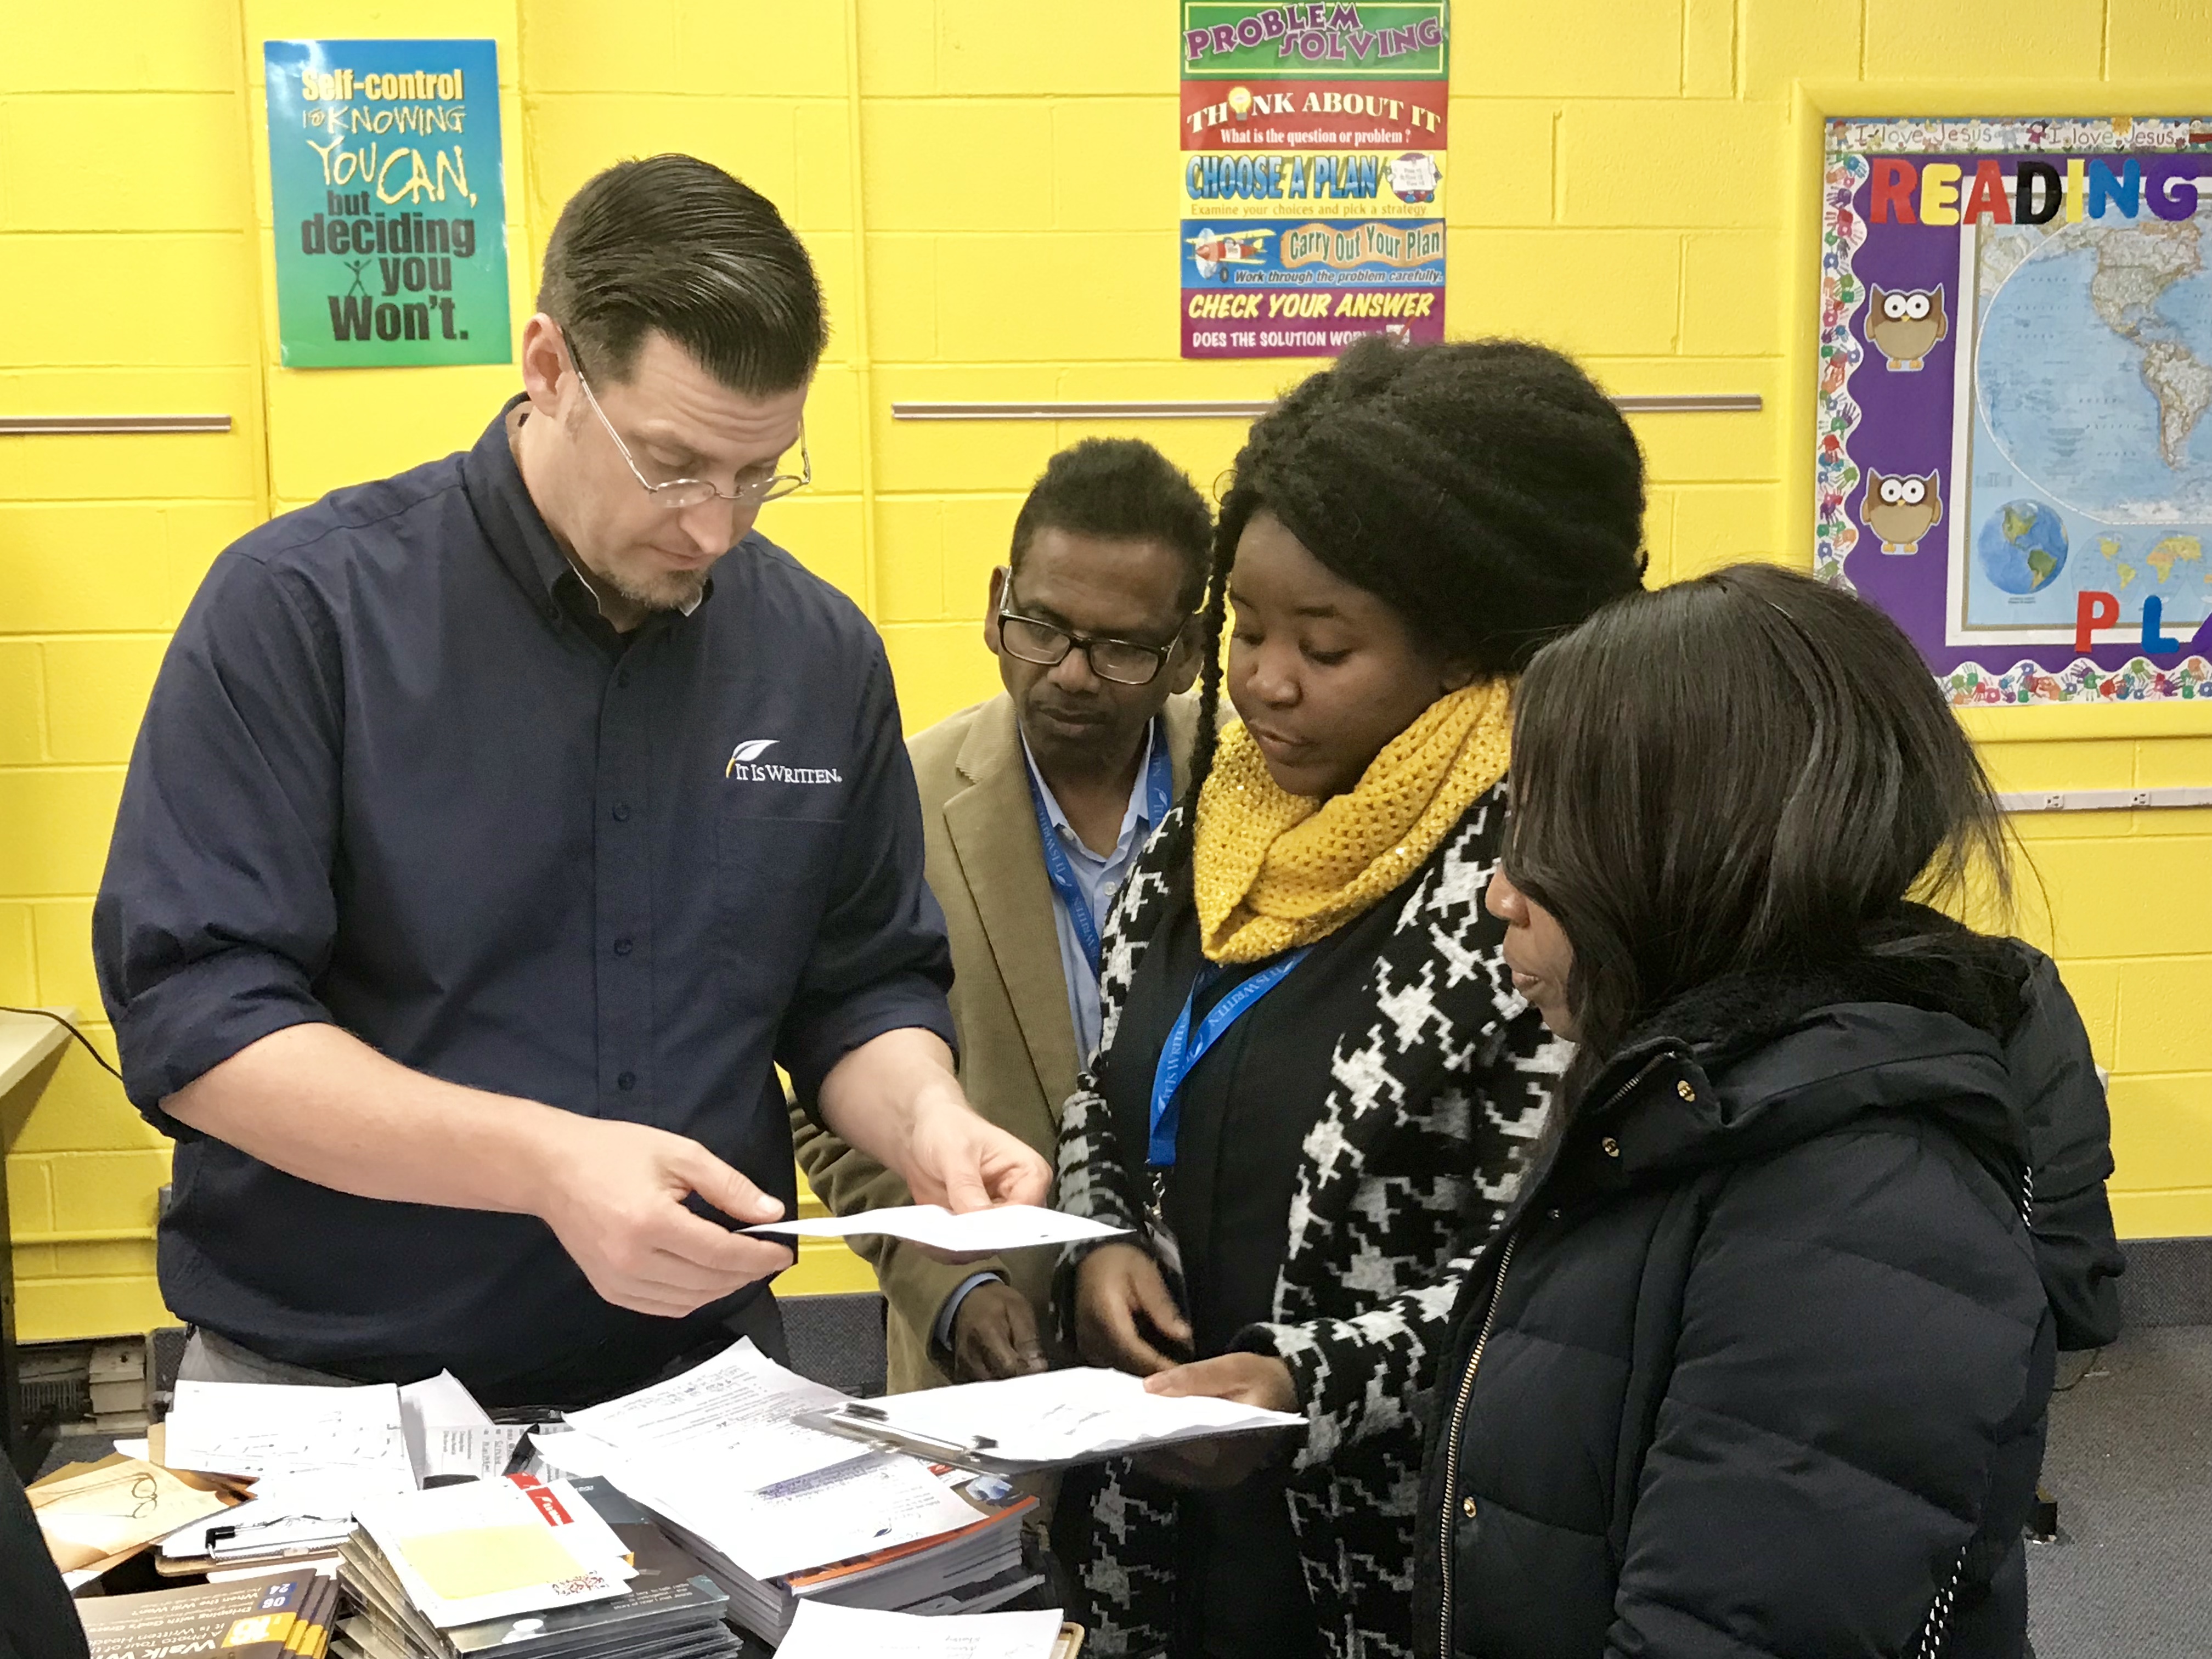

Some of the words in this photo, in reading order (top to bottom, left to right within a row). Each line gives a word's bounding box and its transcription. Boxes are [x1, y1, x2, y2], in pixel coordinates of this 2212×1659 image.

[1184, 2, 1362, 60] PROBLEM
[1279, 16, 1442, 60] SOLVING
[302, 69, 464, 100] Self-control
[327, 105, 467, 136] KNOWING
[1187, 87, 1295, 133] THNK
[1302, 92, 1404, 120] ABOUT
[1411, 105, 1441, 133] IT
[1221, 128, 1251, 143] What
[1254, 128, 1263, 143] is
[1266, 128, 1285, 143] the
[1287, 128, 1337, 147] question
[1339, 132, 1352, 143] or
[1354, 128, 1402, 147] problem
[1854, 125, 1868, 146] I
[1882, 125, 1923, 144] love
[1938, 123, 1992, 144] Jesus
[2049, 126, 2062, 144] I
[2073, 127, 2113, 145] love
[2124, 127, 2175, 145] Jesus
[306, 136, 376, 185] YOU
[376, 145, 477, 208] CAN,
[1186, 155, 1283, 200] CHOOSE
[1288, 155, 1307, 199] A
[1313, 155, 1378, 199] PLAN
[328, 190, 371, 216] but
[1870, 159, 2198, 225] READING
[1191, 204, 1239, 215] Examine
[1243, 206, 1268, 217] your
[1273, 204, 1314, 215] choices
[1318, 204, 1339, 215] and
[1344, 203, 1366, 217] pick
[301, 212, 475, 257] deciding
[1290, 230, 1330, 261] Carry
[1335, 230, 1360, 262] Out
[1366, 224, 1401, 259] Your
[1407, 229, 1440, 259] Plan
[380, 257, 453, 296] you
[1235, 270, 1265, 283] Work
[1268, 270, 1313, 284] through
[1317, 271, 1335, 281] the
[1338, 270, 1385, 284] problem
[1389, 269, 1442, 283] carefully.
[328, 295, 469, 341] Won't.
[1188, 293, 1263, 319] CHECK
[1268, 293, 1332, 318] YOUR
[1334, 292, 1435, 318] ANSWER
[1193, 331, 1227, 347] DOES
[1230, 331, 1256, 347] THE
[1260, 331, 1326, 347] SOLUTION
[270, 1583, 290, 1595] 24
[142, 1639, 215, 1659] Walk
